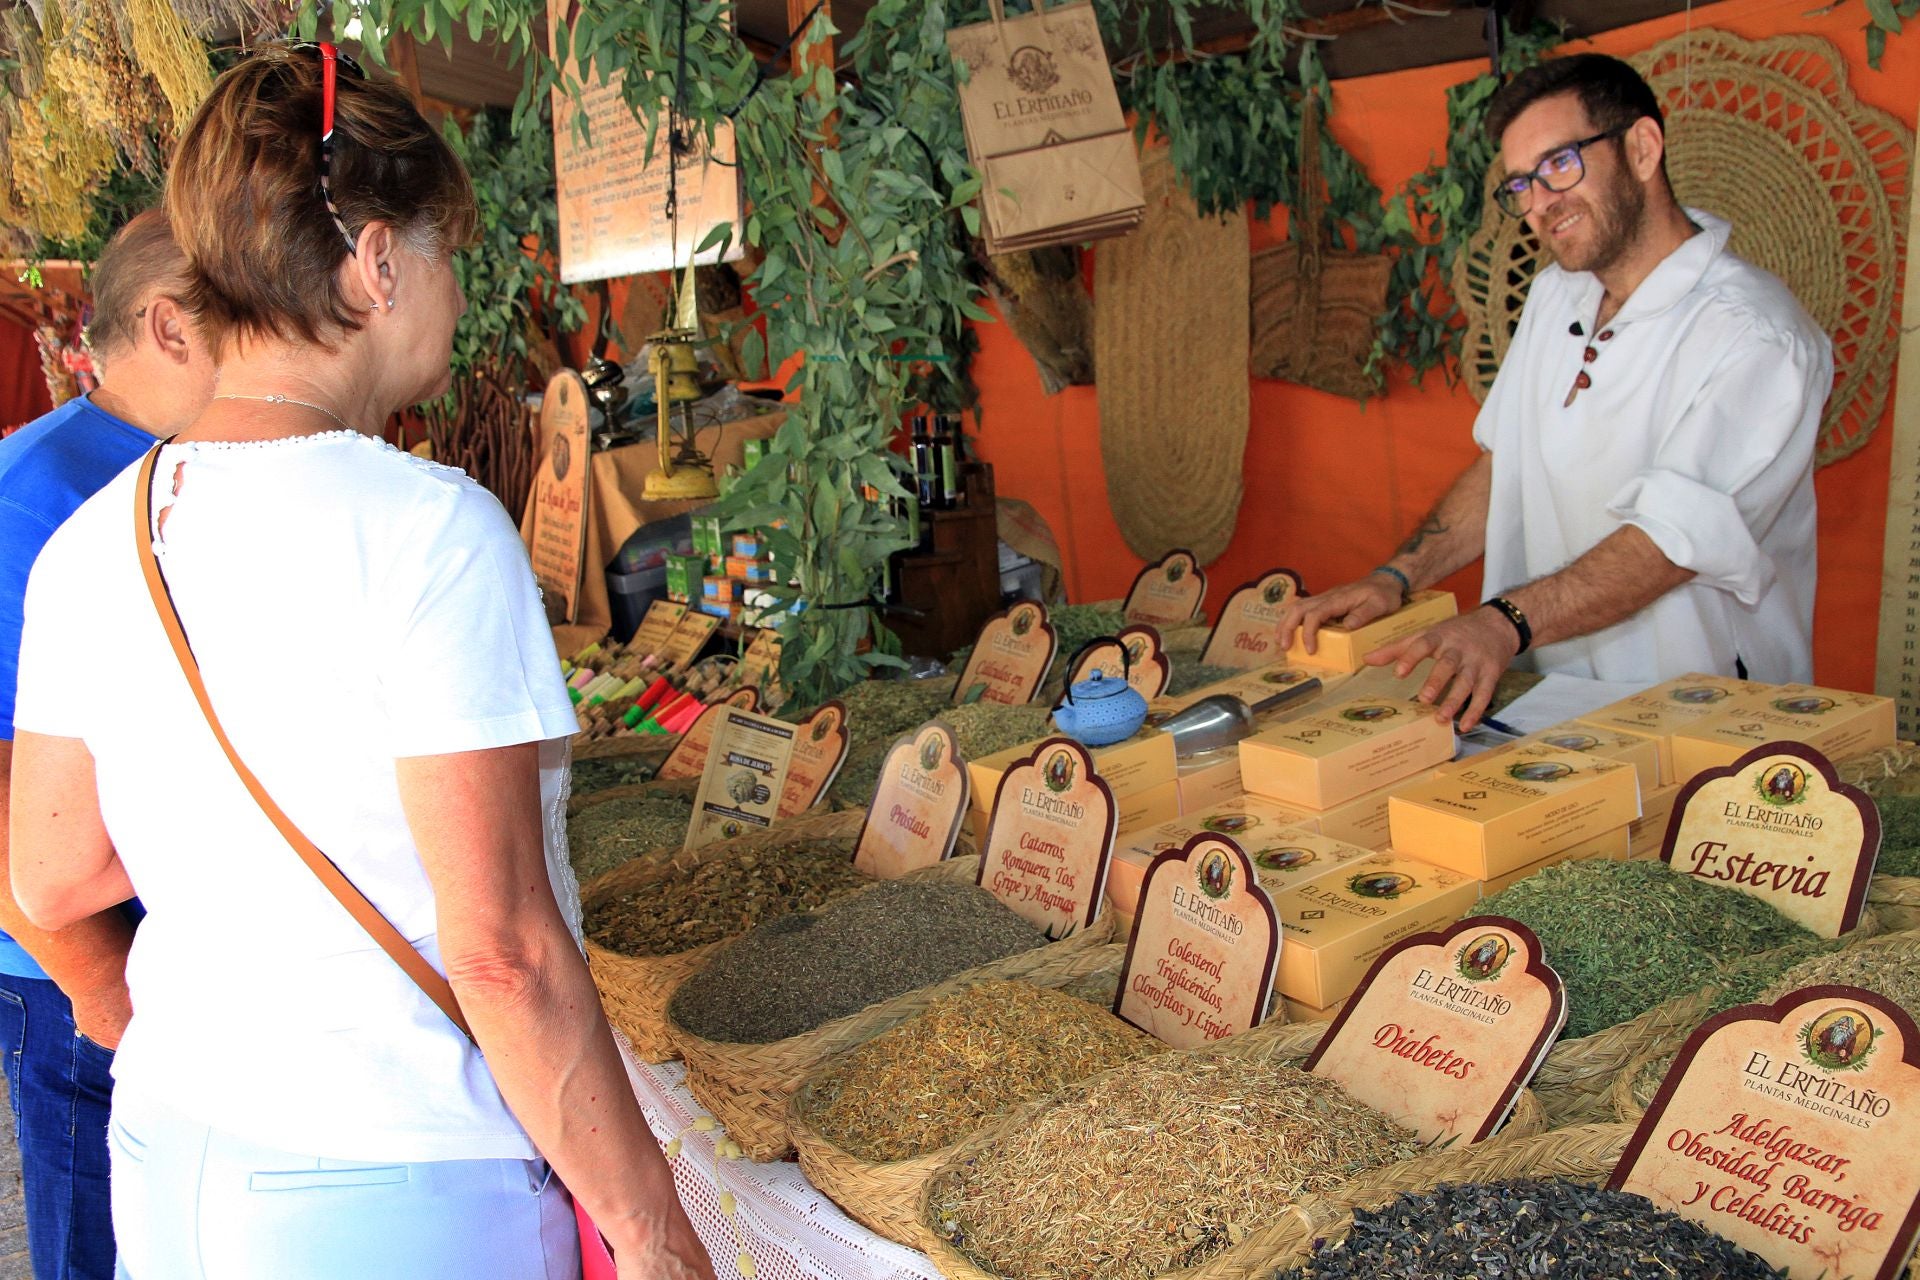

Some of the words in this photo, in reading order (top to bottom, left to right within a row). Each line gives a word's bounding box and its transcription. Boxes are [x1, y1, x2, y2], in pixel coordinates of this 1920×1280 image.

[993, 101, 1015, 119] EL
[1234, 632, 1268, 653] Poleo
[900, 763, 910, 780] EL
[890, 804, 931, 840] Próstata
[1022, 788, 1034, 806] EL
[1037, 791, 1084, 820] ERMITAÑO
[1724, 801, 1741, 818] EL
[1747, 804, 1823, 831] ERMITAÑO
[1020, 831, 1065, 863] Catarros,
[1726, 819, 1760, 829] PLANTAS
[1761, 823, 1814, 838] MEDICINALES
[1002, 849, 1051, 884] Ronquera,
[1056, 866, 1076, 891] Tos,
[1687, 841, 1831, 898] Estevia
[993, 871, 1022, 897] Gripe
[1020, 884, 1032, 902] y
[1029, 884, 1077, 913] Anginas
[1172, 886, 1187, 909] EL
[1188, 893, 1244, 937] ERMITAÑO
[1300, 885, 1319, 896] EL
[1319, 892, 1387, 917] ERMITAÑO
[1174, 908, 1198, 927] PLANTAS
[1199, 920, 1237, 945] MEDICINALES
[1168, 937, 1226, 984] Colesterol,
[1133, 974, 1185, 1017] Clorofitos
[1182, 1006, 1195, 1027] y
[1156, 958, 1223, 1014] Triglicéridos,
[1412, 969, 1434, 991] EL
[1434, 976, 1512, 1016] ERMITAÑO
[1410, 990, 1443, 1007] PLANTAS
[1443, 1002, 1497, 1025] MEDICINALES
[1372, 1023, 1476, 1080] Diabetes
[1743, 1051, 1777, 1080] EL
[1775, 1061, 1891, 1119] ERMITAÑO
[1743, 1078, 1792, 1102] PLANTAS
[1793, 1096, 1872, 1130] MEDICINALES
[1713, 1113, 1851, 1183] Adelgazar,
[1667, 1128, 1785, 1193] Obesidad,
[1781, 1173, 1885, 1233] Barriga
[1681, 1181, 1711, 1206] y
[1710, 1185, 1817, 1245] Celulitis
